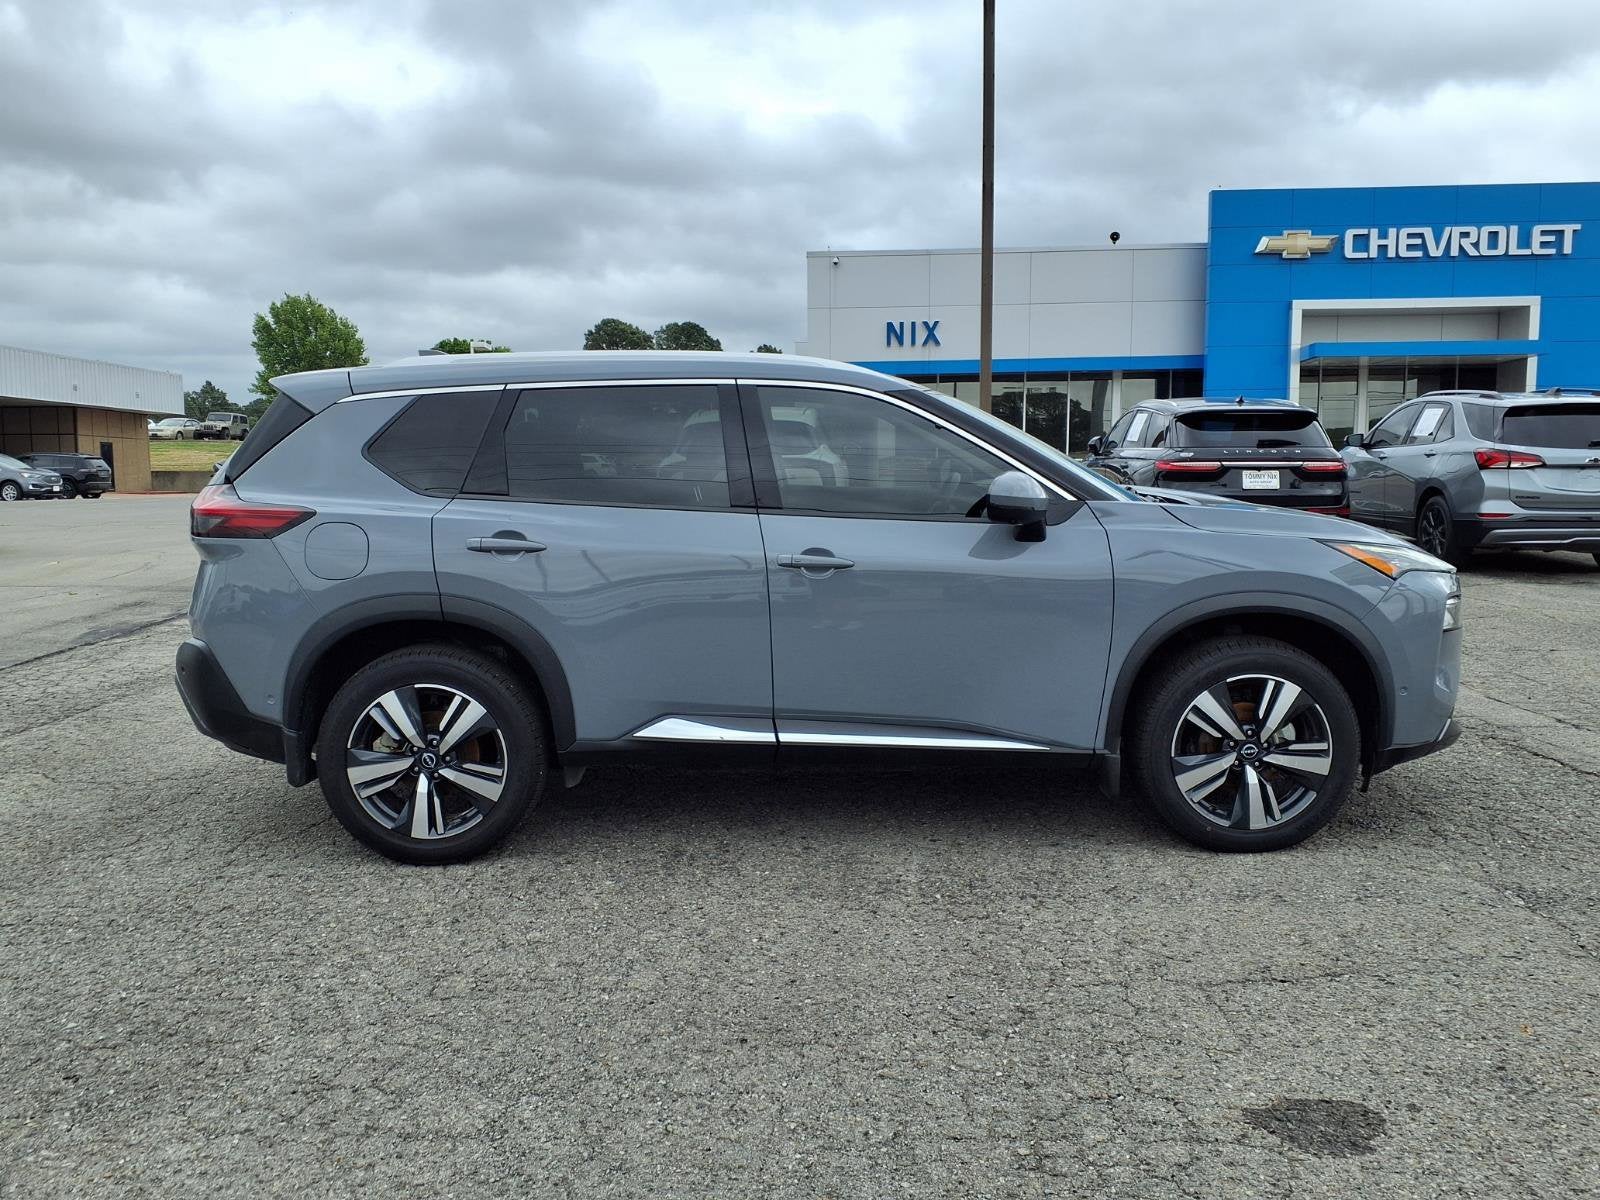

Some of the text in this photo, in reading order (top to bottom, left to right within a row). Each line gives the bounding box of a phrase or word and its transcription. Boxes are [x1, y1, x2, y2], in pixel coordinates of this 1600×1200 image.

[1344, 223, 1582, 259] CHEVROLET
[886, 320, 942, 347] NIX
[1244, 472, 1278, 480] TOMMY NIX
